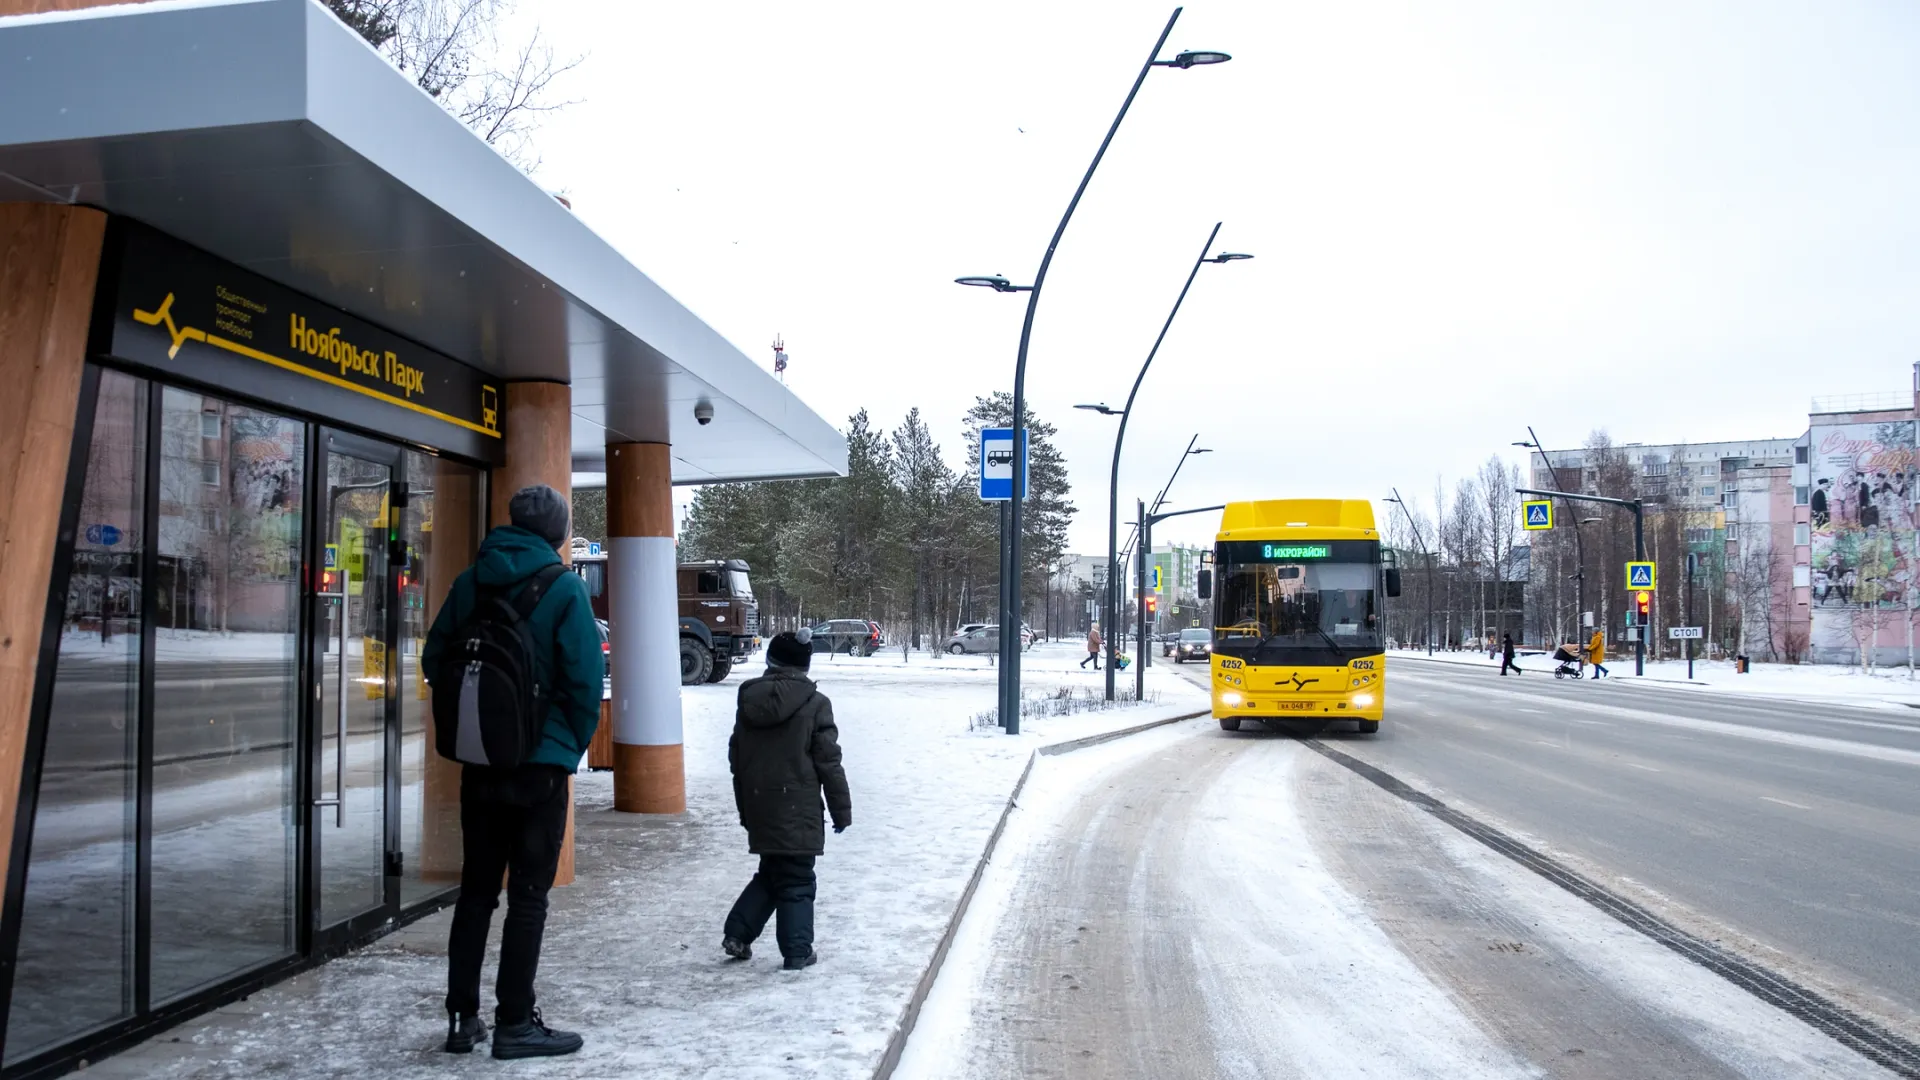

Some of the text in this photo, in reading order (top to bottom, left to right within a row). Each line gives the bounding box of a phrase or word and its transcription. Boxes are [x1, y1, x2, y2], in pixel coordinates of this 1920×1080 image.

[290, 312, 424, 398] Ноябрьск Парк
[1264, 544, 1272, 558] 8
[1673, 628, 1698, 637] СТОП
[1220, 659, 1242, 670] 4252
[1352, 660, 1374, 670] 4252
